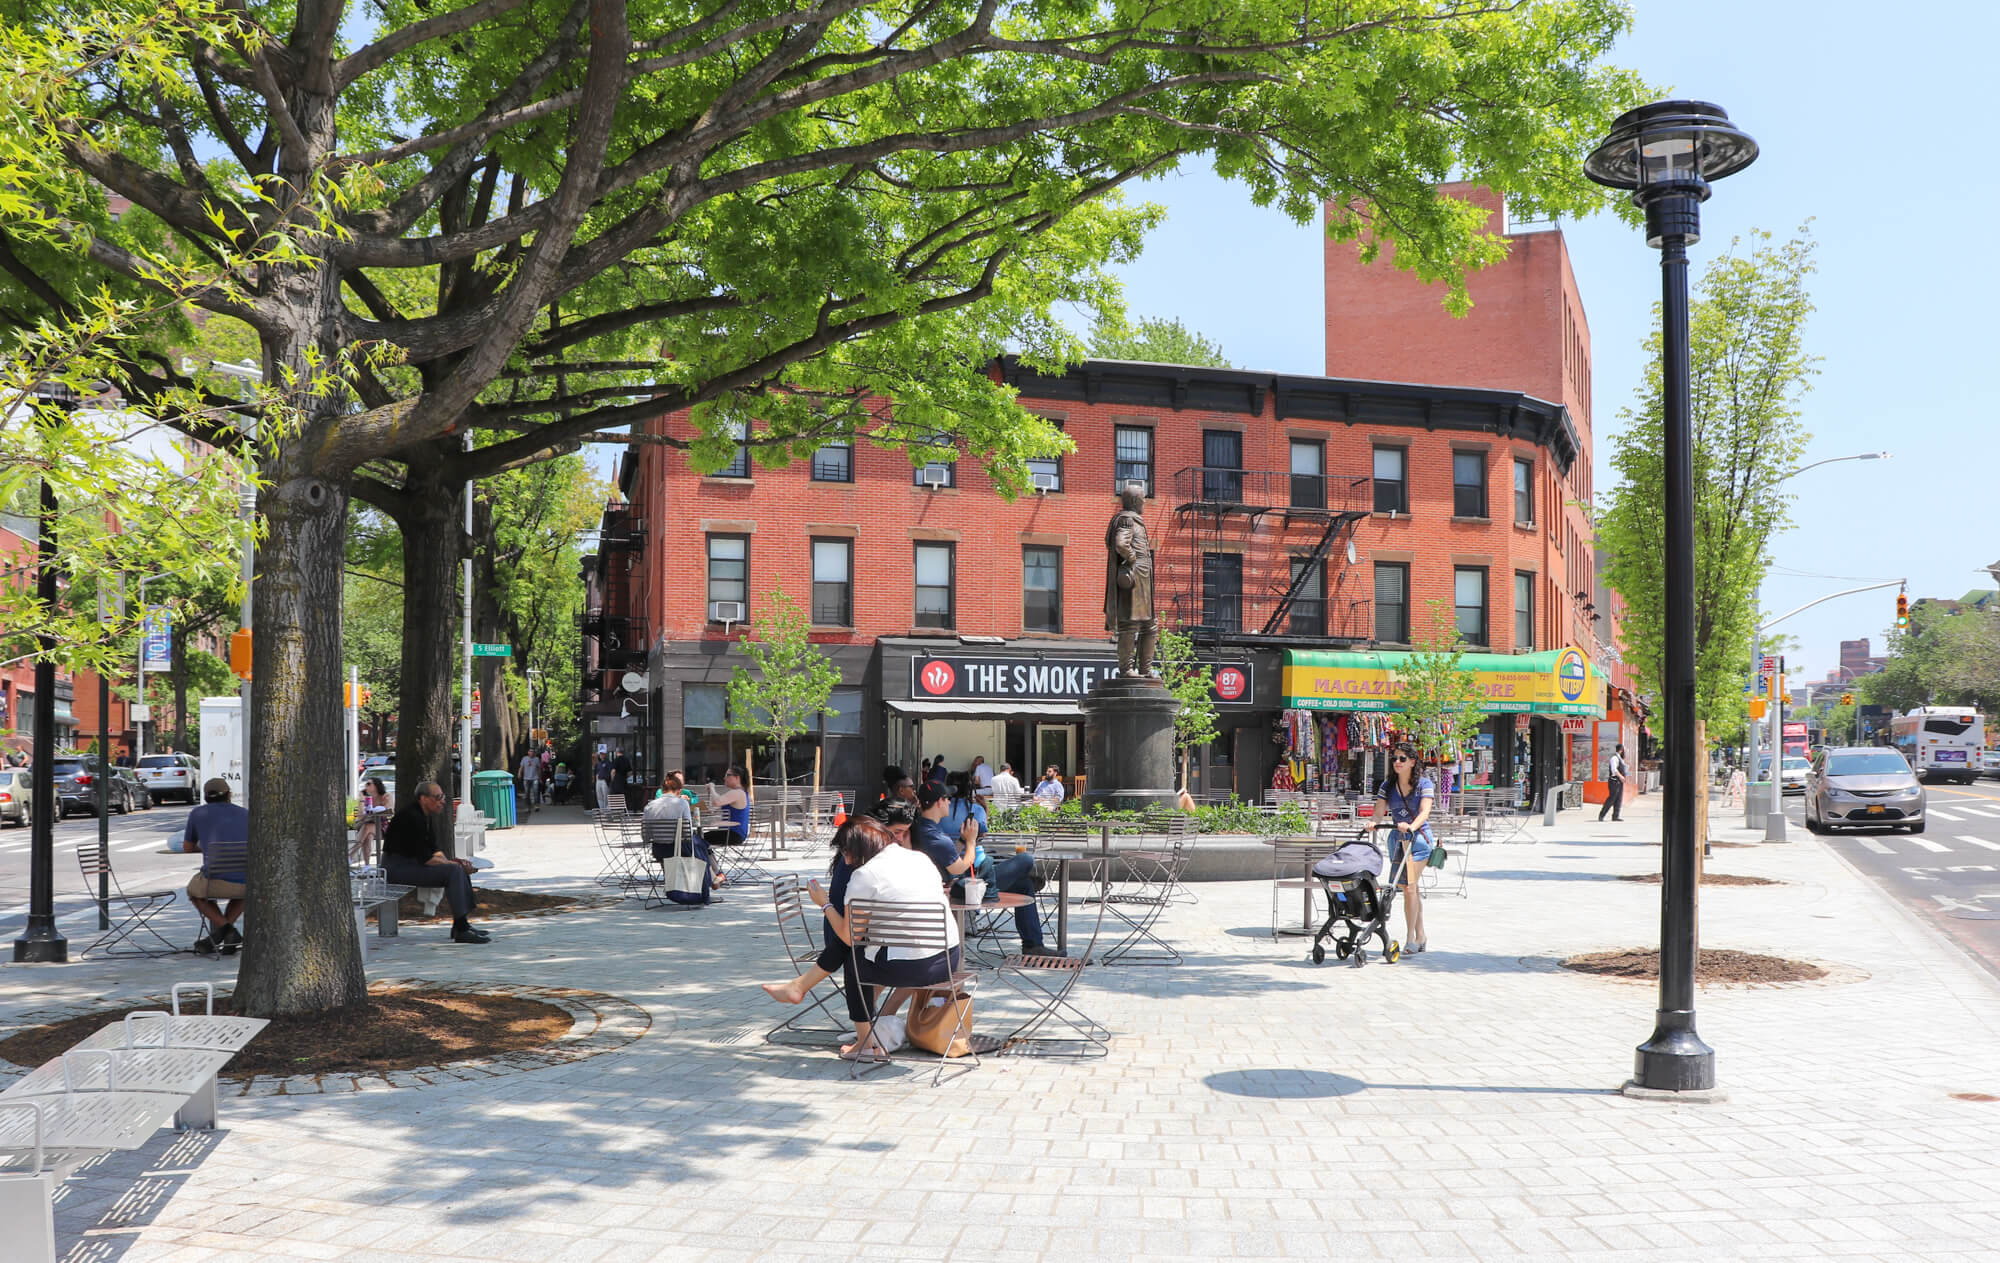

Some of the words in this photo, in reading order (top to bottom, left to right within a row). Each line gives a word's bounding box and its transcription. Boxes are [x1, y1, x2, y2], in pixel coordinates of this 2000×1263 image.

[484, 644, 504, 652] Elliott
[964, 664, 1009, 693] THE
[1013, 665, 1095, 694] SMOKE
[1222, 672, 1237, 686] 87
[1313, 678, 1433, 697] MAGAZIN
[1297, 699, 1319, 707] COFFEE
[1563, 719, 1584, 728] ATM
